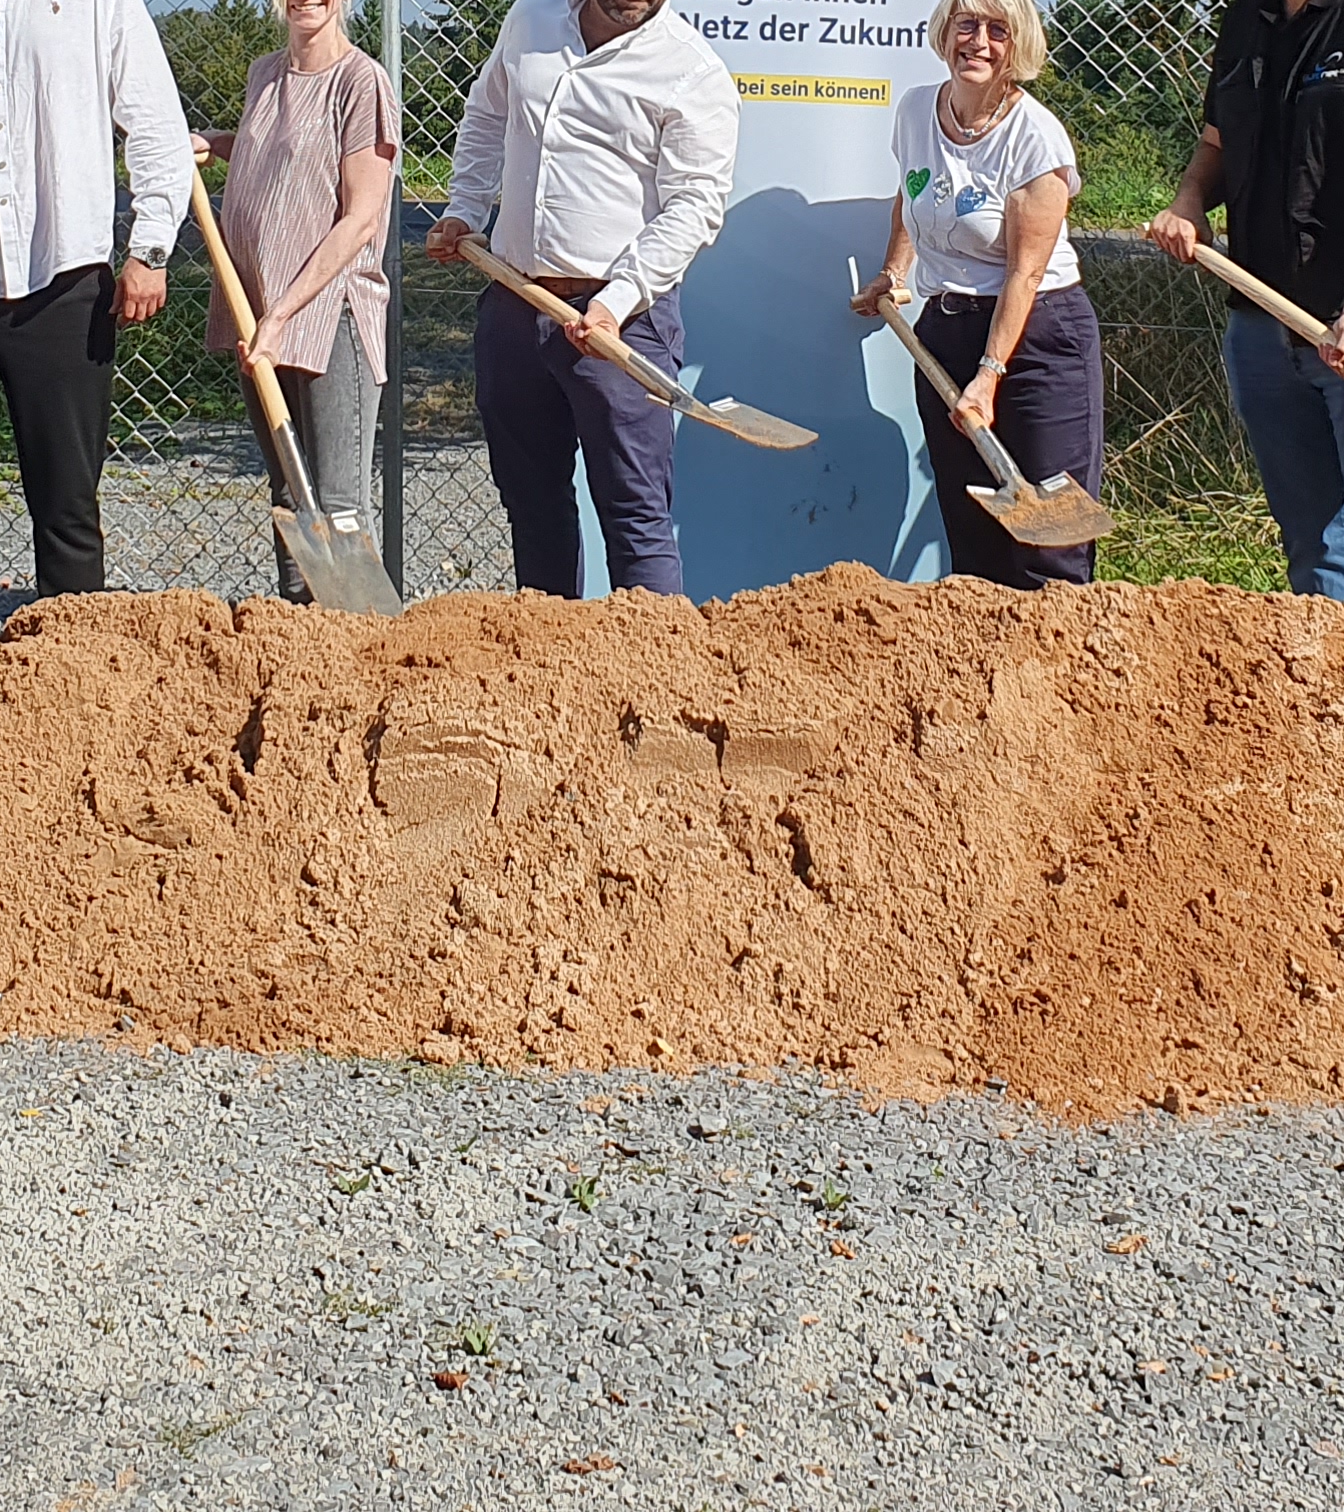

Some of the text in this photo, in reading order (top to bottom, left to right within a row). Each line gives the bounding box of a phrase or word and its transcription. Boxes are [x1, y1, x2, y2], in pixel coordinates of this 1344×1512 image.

[759, 15, 809, 42] der
[819, 17, 927, 48] Zukunf
[770, 80, 808, 97] sein
[814, 81, 886, 100] können!
